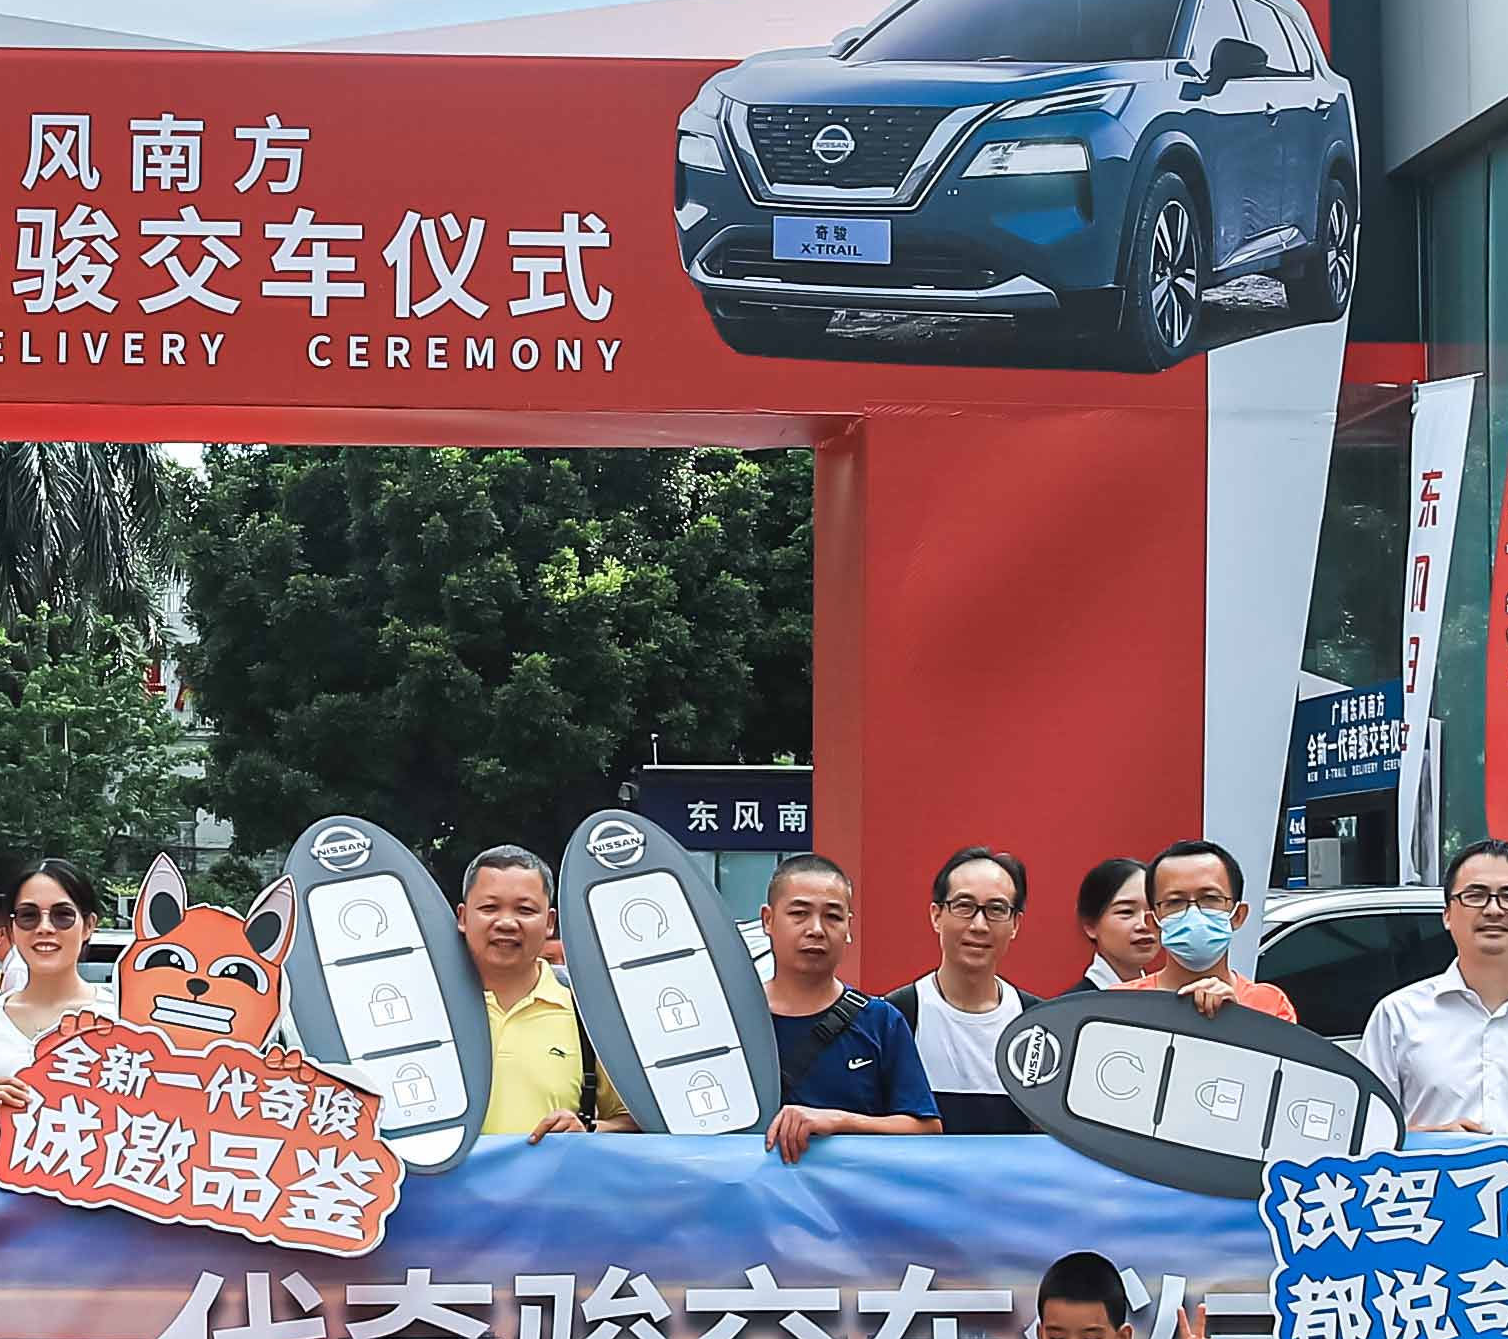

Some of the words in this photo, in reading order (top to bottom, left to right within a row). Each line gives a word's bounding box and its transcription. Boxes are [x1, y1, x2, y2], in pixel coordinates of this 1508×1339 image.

[800, 241, 863, 258] X-TRAIL
[815, 224, 848, 241] 奇骏
[307, 333, 624, 373] CEREMONY
[686, 799, 809, 834] 东风南
[317, 842, 368, 857] NISSAN
[592, 836, 643, 853] NISSAN
[1027, 1031, 1045, 1084] NISSAN
[47, 1036, 364, 1141] 全新一代奇骏
[10, 1093, 388, 1240] 诚邀品鉴
